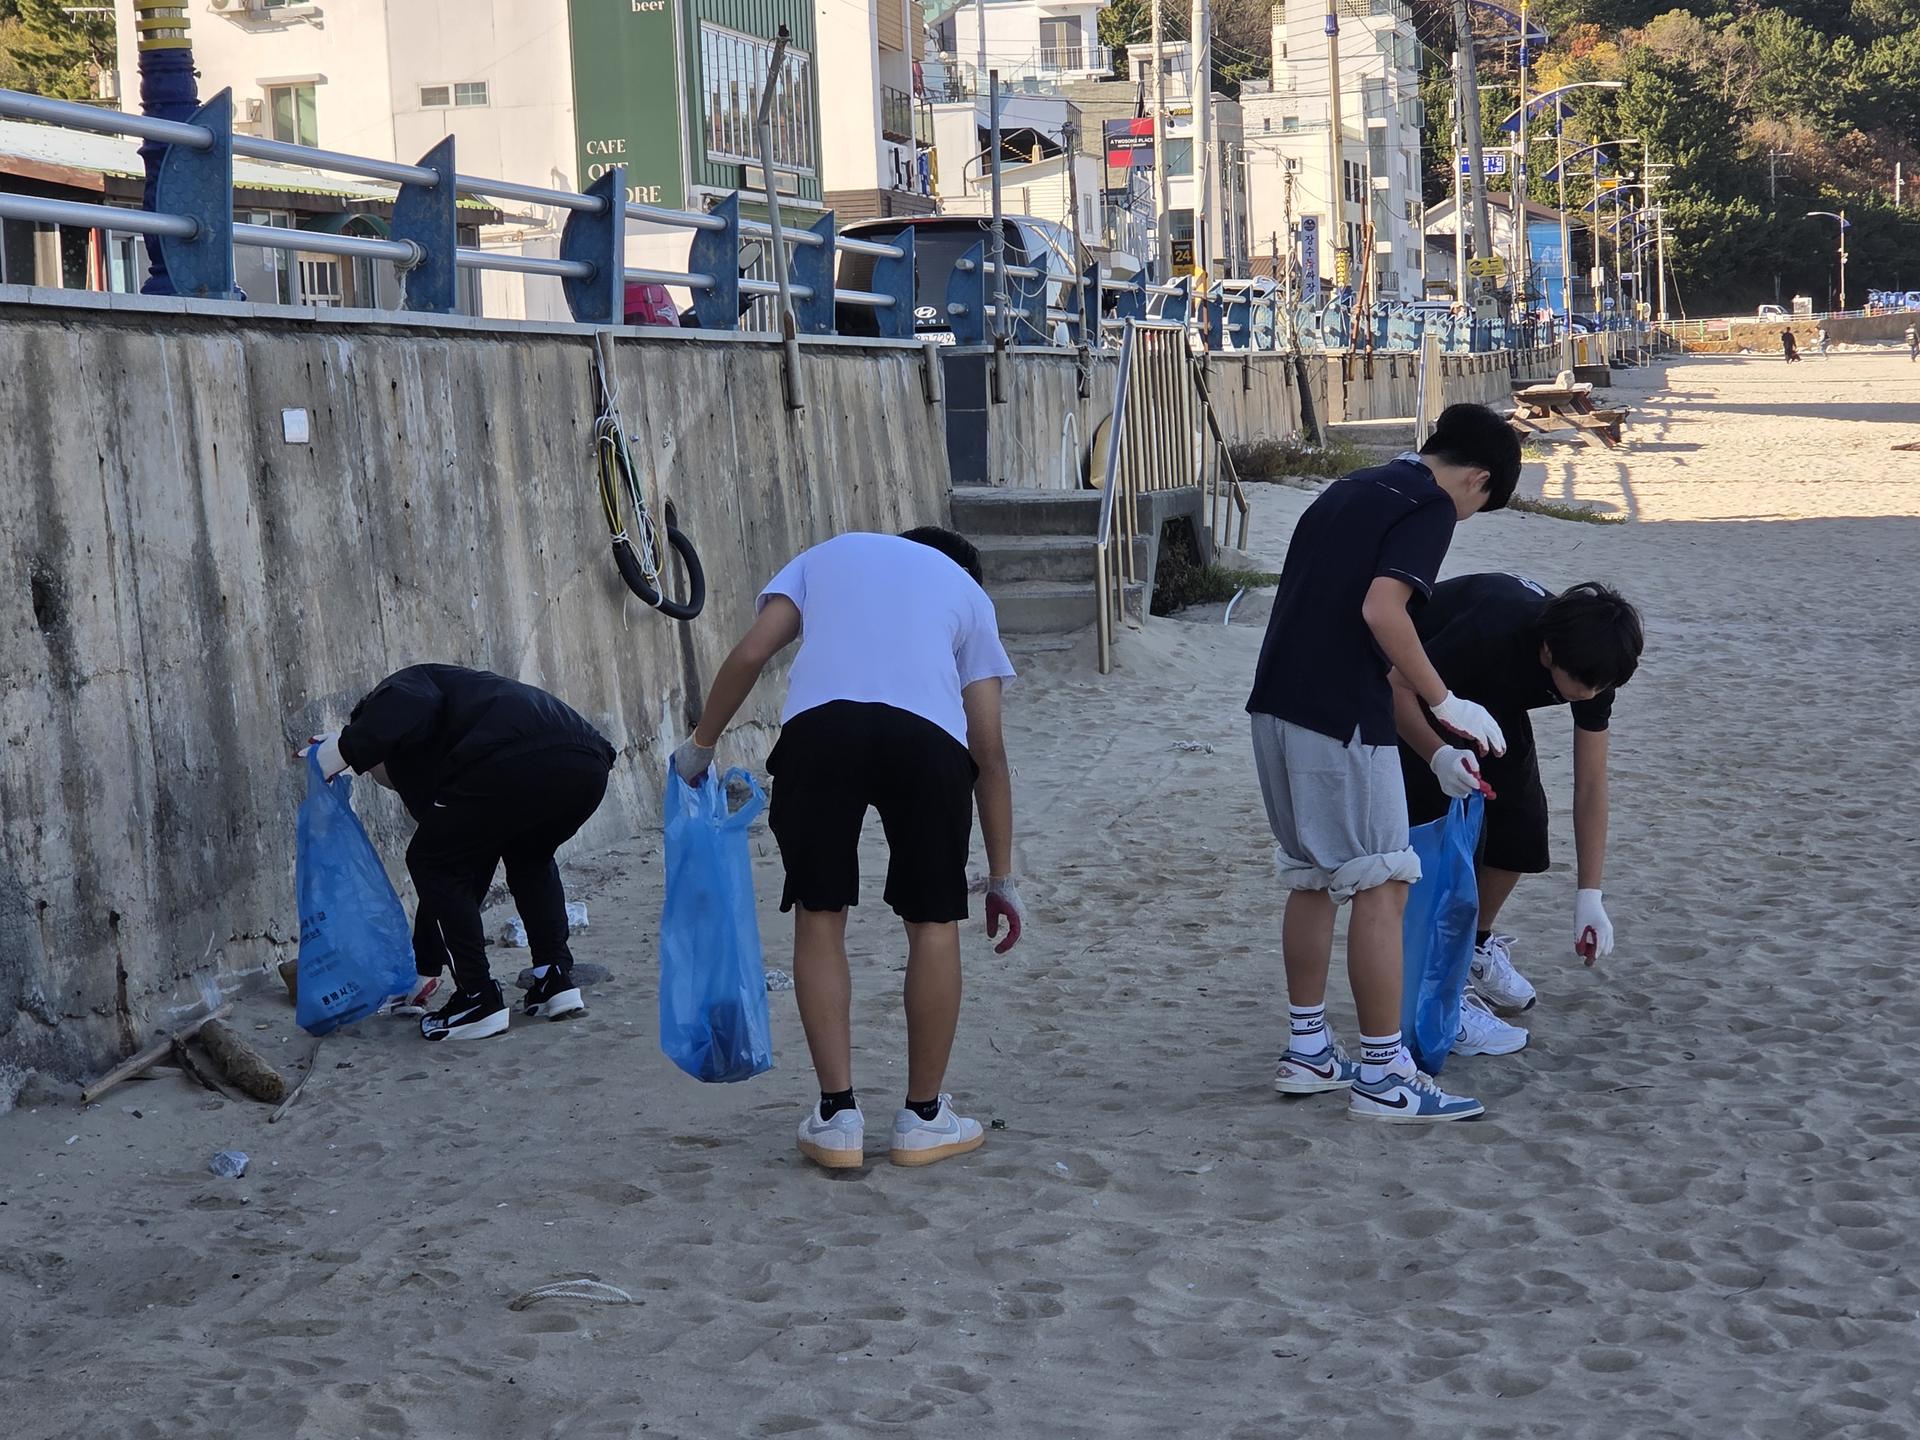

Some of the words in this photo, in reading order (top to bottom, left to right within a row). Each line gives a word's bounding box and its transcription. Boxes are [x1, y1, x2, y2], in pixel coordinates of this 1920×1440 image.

[631, 0, 665, 12] beer
[586, 139, 626, 155] CAFE
[625, 185, 661, 204] ORE
[1175, 250, 1191, 262] 24
[1365, 1049, 1399, 1058] Kodak
